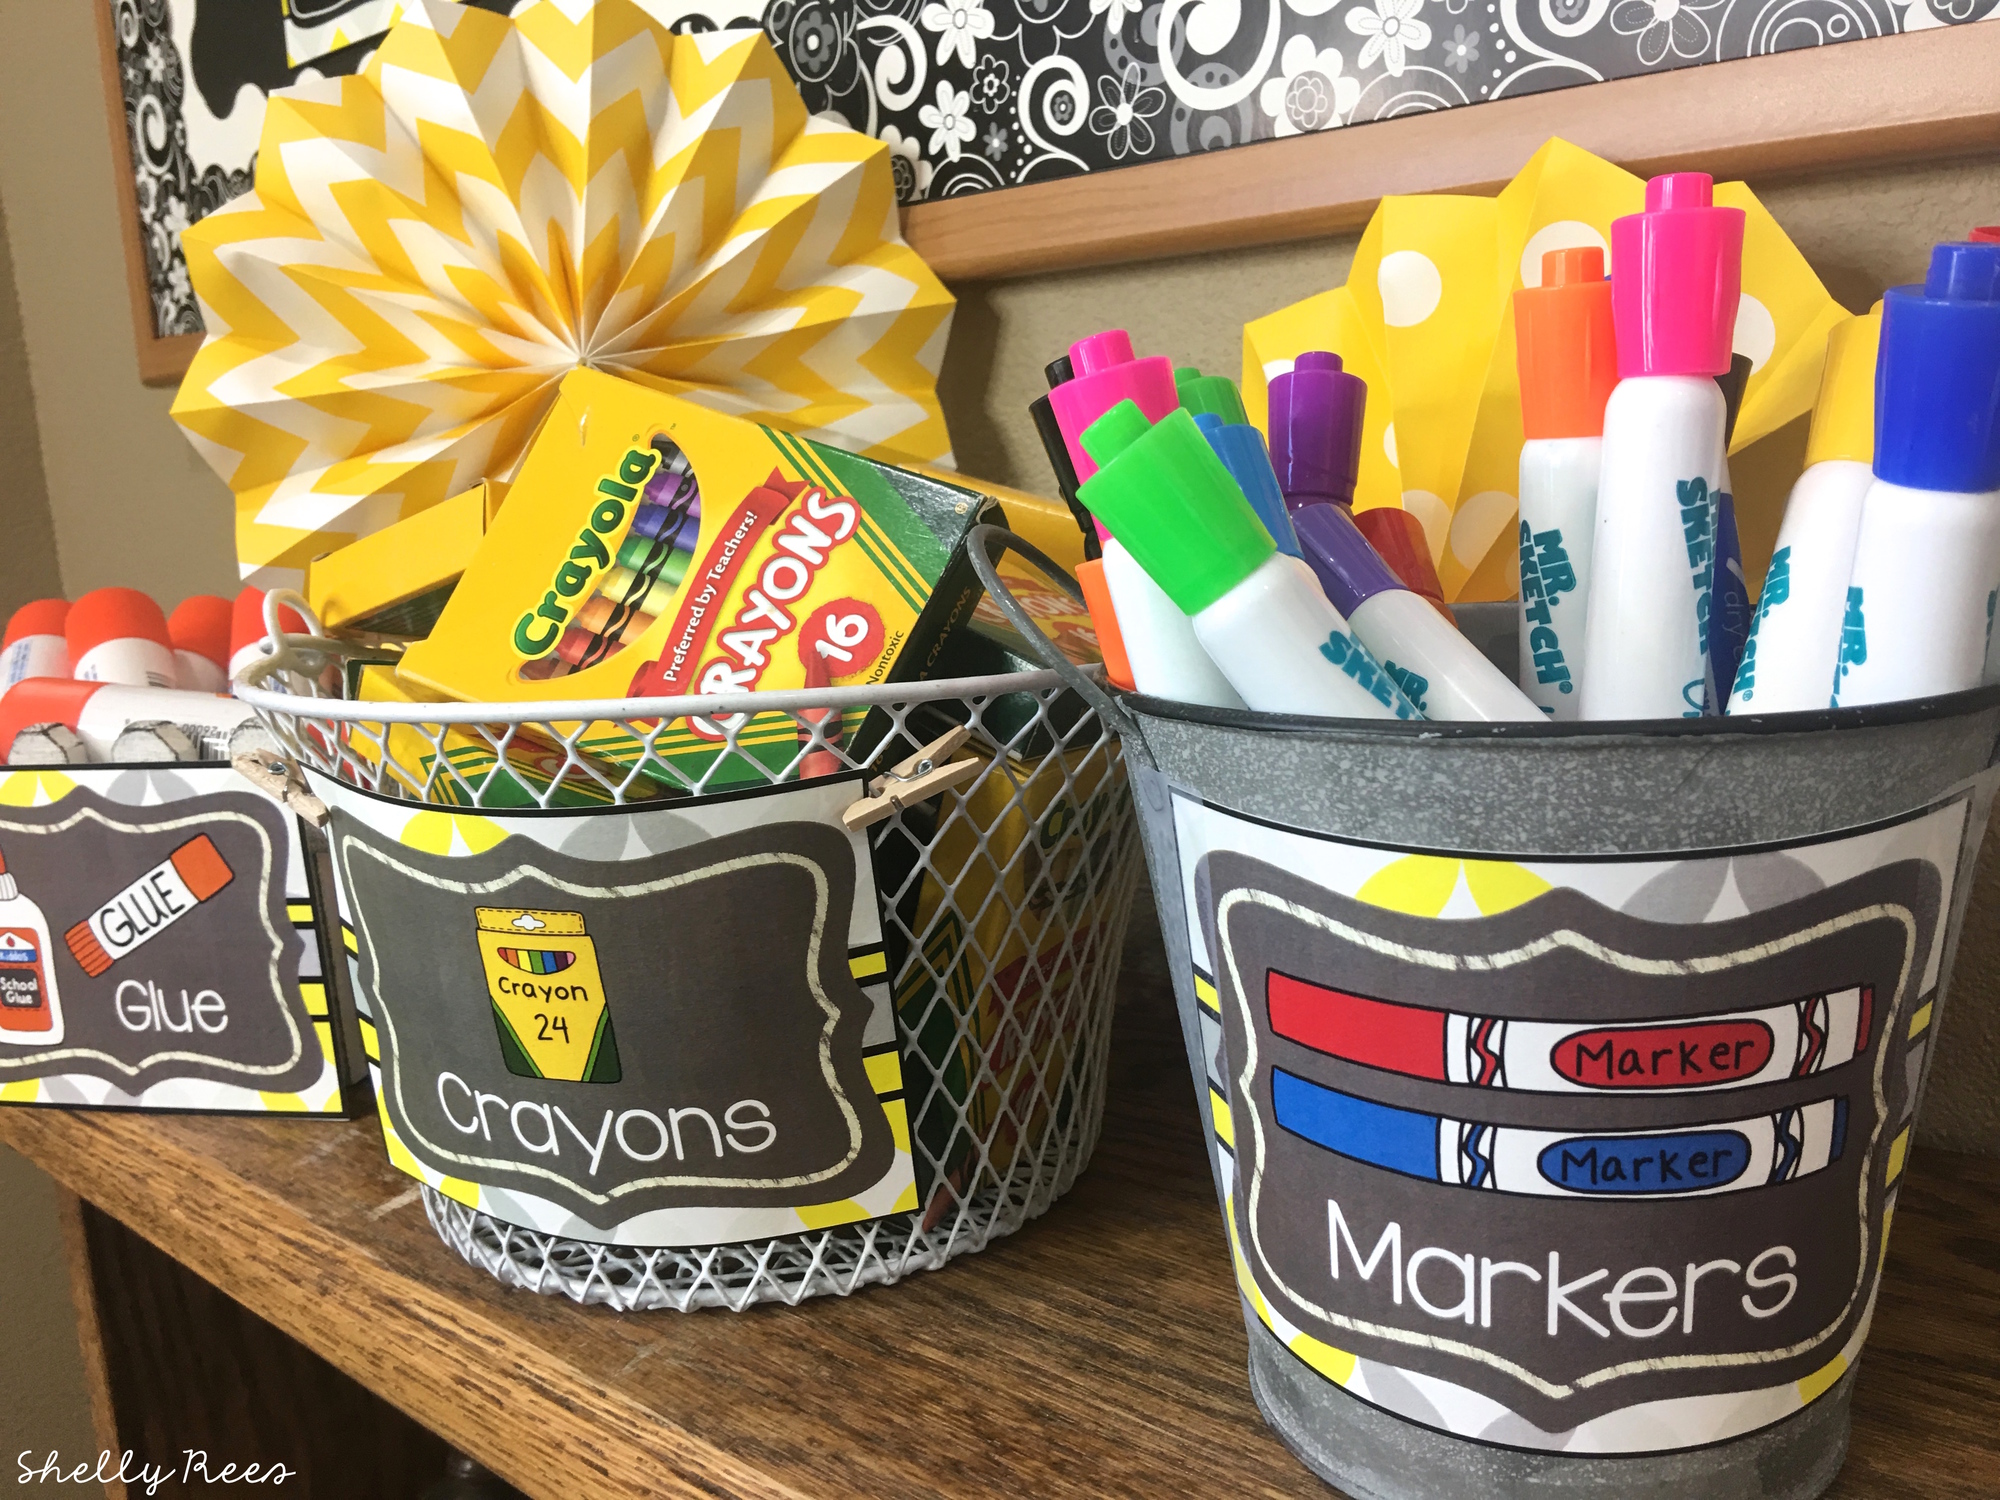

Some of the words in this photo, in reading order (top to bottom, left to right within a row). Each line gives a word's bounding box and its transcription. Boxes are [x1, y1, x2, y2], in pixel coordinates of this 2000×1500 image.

[514, 450, 656, 655] Crayola
[706, 511, 758, 580] Teachers!
[1534, 528, 1577, 606] MR.
[701, 586, 717, 609] by
[663, 605, 705, 681] Preferred
[815, 614, 868, 662] 16
[927, 586, 971, 667] CRAYONS
[866, 630, 904, 685] Nontoxic
[100, 870, 186, 947] GLUE
[0, 976, 38, 991] School
[6, 990, 33, 1004] Glue
[115, 979, 229, 1034] Glue
[497, 976, 589, 1003] Crayon
[534, 1013, 571, 1044] 24
[1576, 1039, 1755, 1080] Marker
[437, 1071, 777, 1176] Crayons
[1561, 1147, 1733, 1186] Marker
[1327, 1199, 1799, 1339] Markers
